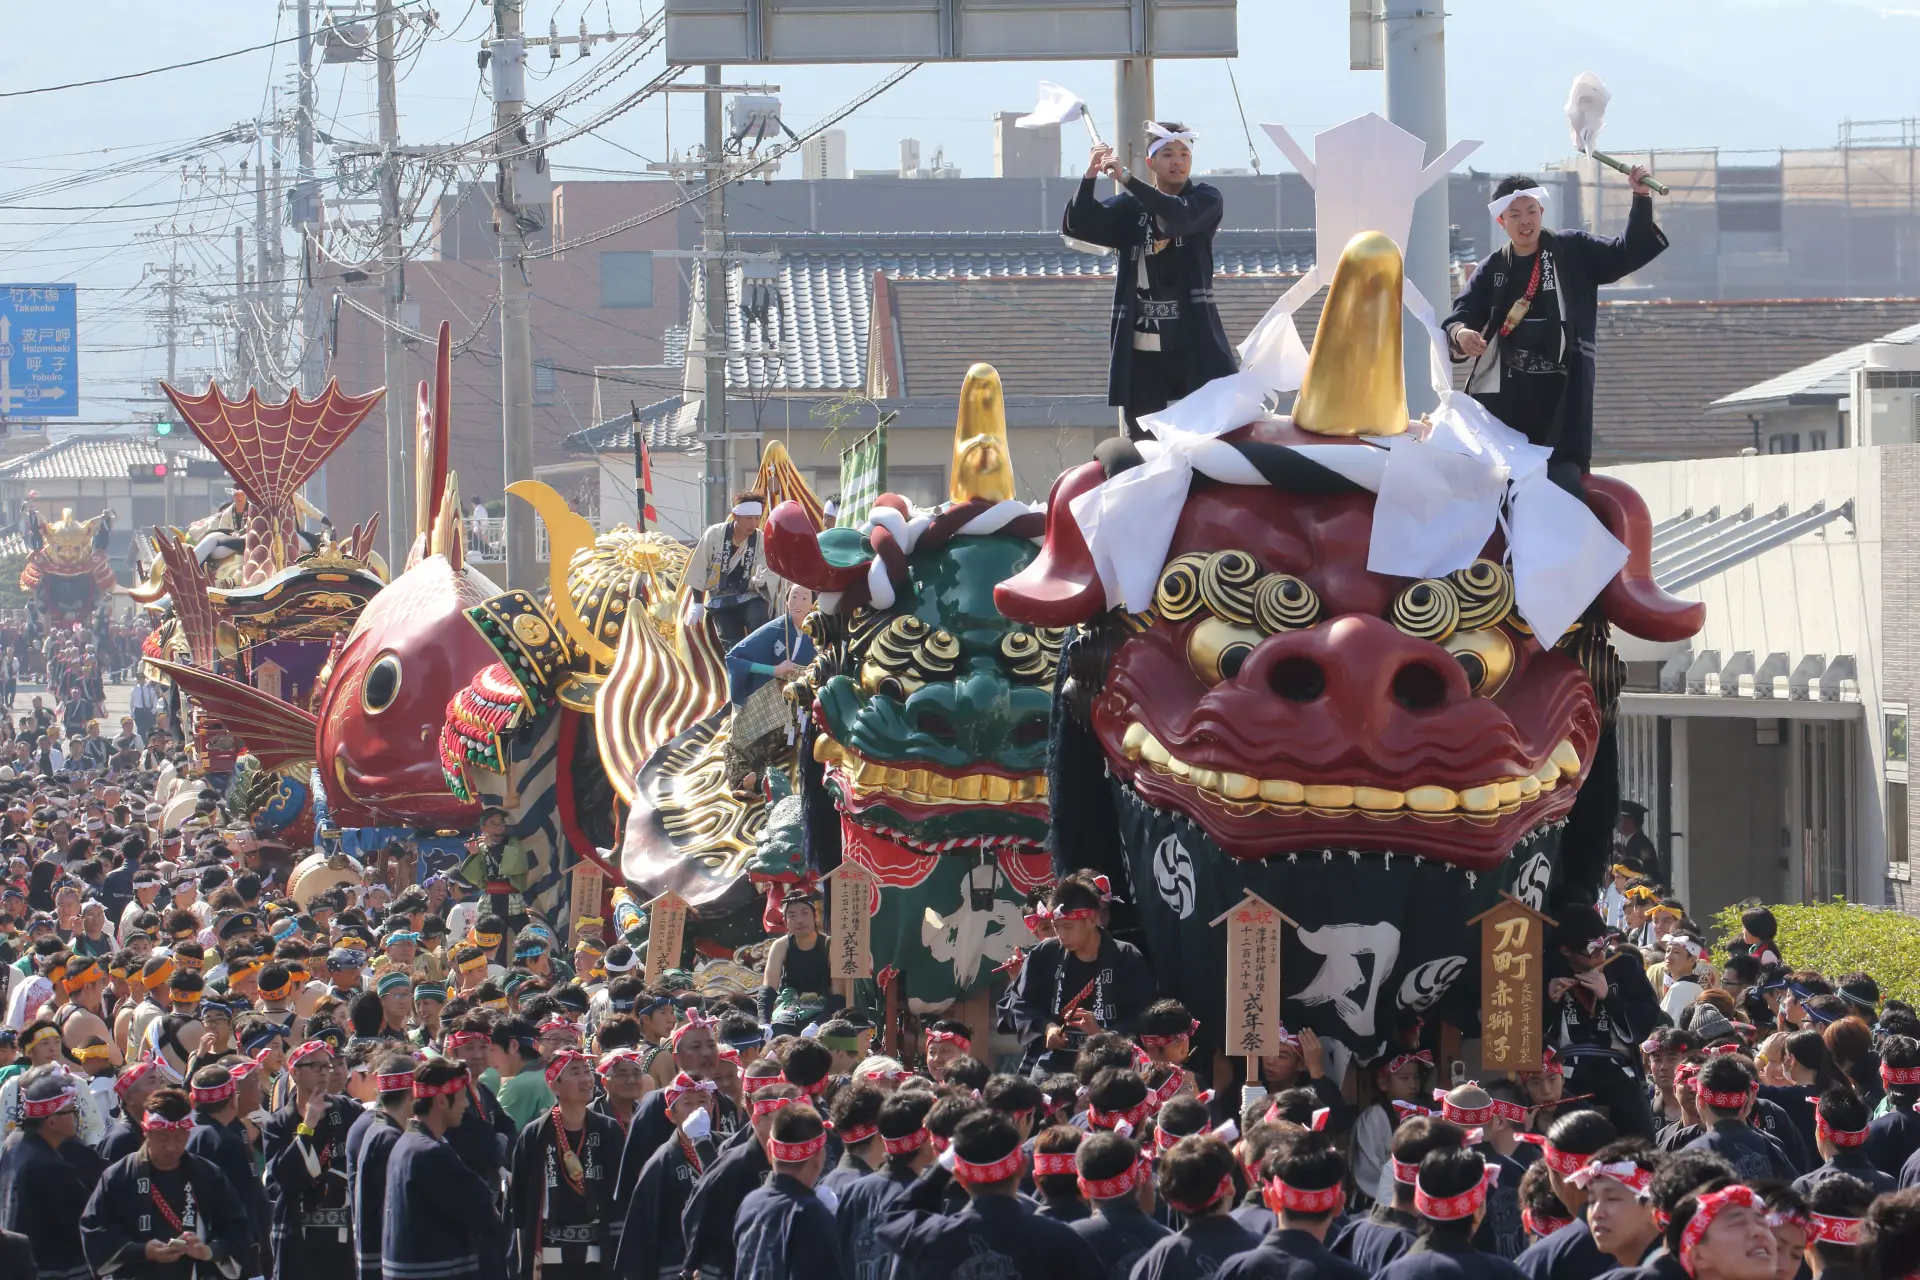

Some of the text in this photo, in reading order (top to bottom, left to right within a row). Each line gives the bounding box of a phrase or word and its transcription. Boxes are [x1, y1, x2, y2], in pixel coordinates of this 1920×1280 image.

[10, 287, 59, 302] 竹木場
[14, 304, 55, 312] Takekoba
[21, 328, 71, 343] 波戸岬
[22, 345, 70, 353] Hatomisaki
[26, 357, 67, 371] 呼子
[32, 373, 63, 381] Yobuko
[26, 388, 38, 398] 23
[841, 882, 849, 930] 千二百六十年
[1235, 910, 1273, 924] 奉祝
[841, 931, 860, 974] 式年祭
[1240, 926, 1252, 990] 千二百六十年
[1288, 920, 1401, 1036] 刀
[1240, 992, 1264, 1052] 式年祭
[1486, 980, 1514, 1062] 赤獅子
